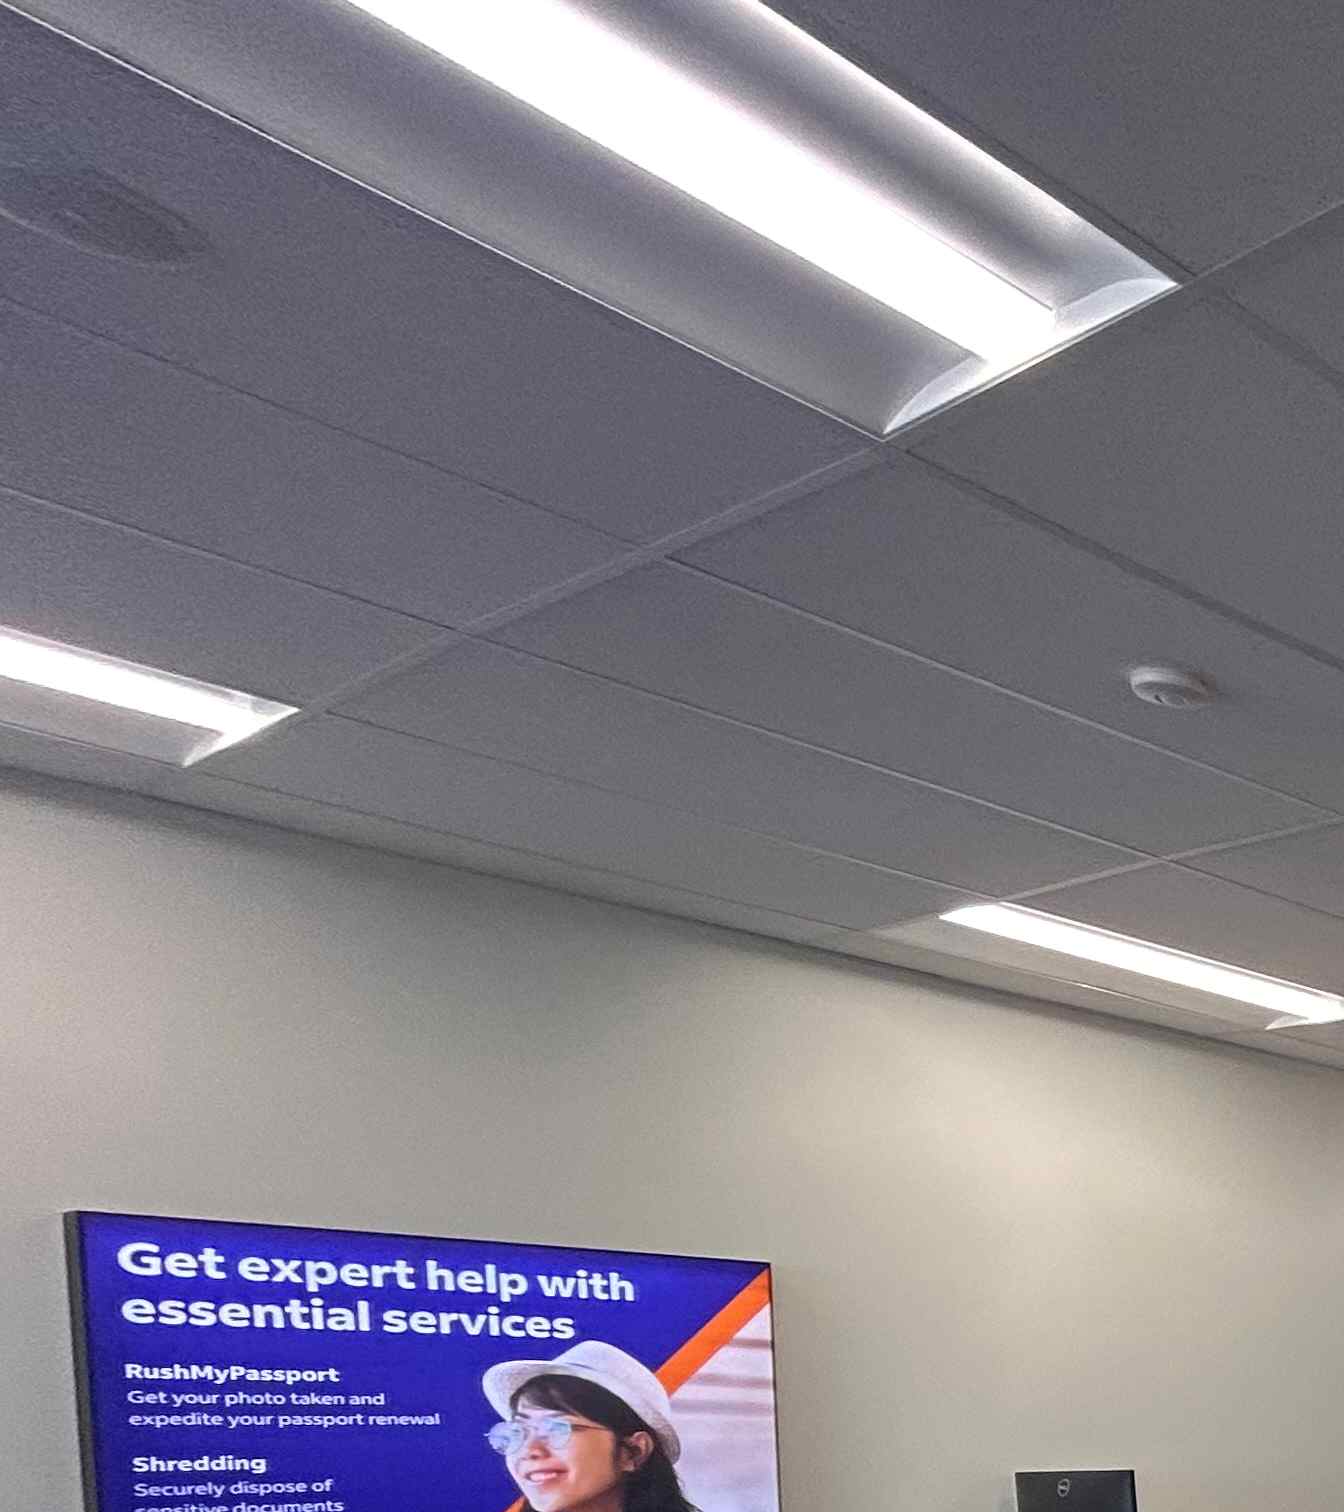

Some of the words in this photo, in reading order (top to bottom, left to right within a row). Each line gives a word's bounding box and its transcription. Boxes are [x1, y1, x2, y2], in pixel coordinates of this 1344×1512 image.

[117, 1242, 227, 1279] Get
[238, 1256, 416, 1292] expert
[426, 1259, 528, 1302] help
[536, 1269, 635, 1301] with
[121, 1298, 370, 1331] essential
[383, 1306, 576, 1339] services
[124, 1364, 341, 1384] RushMyPassport
[127, 1391, 167, 1405] Get
[171, 1392, 220, 1407] your
[225, 1392, 286, 1407] photo
[290, 1393, 345, 1405] taken
[349, 1393, 385, 1405] and
[128, 1413, 224, 1428] expedite
[227, 1414, 274, 1428] your
[278, 1413, 363, 1428] passport
[367, 1413, 441, 1425] renewal
[132, 1455, 267, 1474] Shredding
[134, 1482, 225, 1497] Securely
[229, 1480, 308, 1496] dispose
[311, 1479, 334, 1492] of
